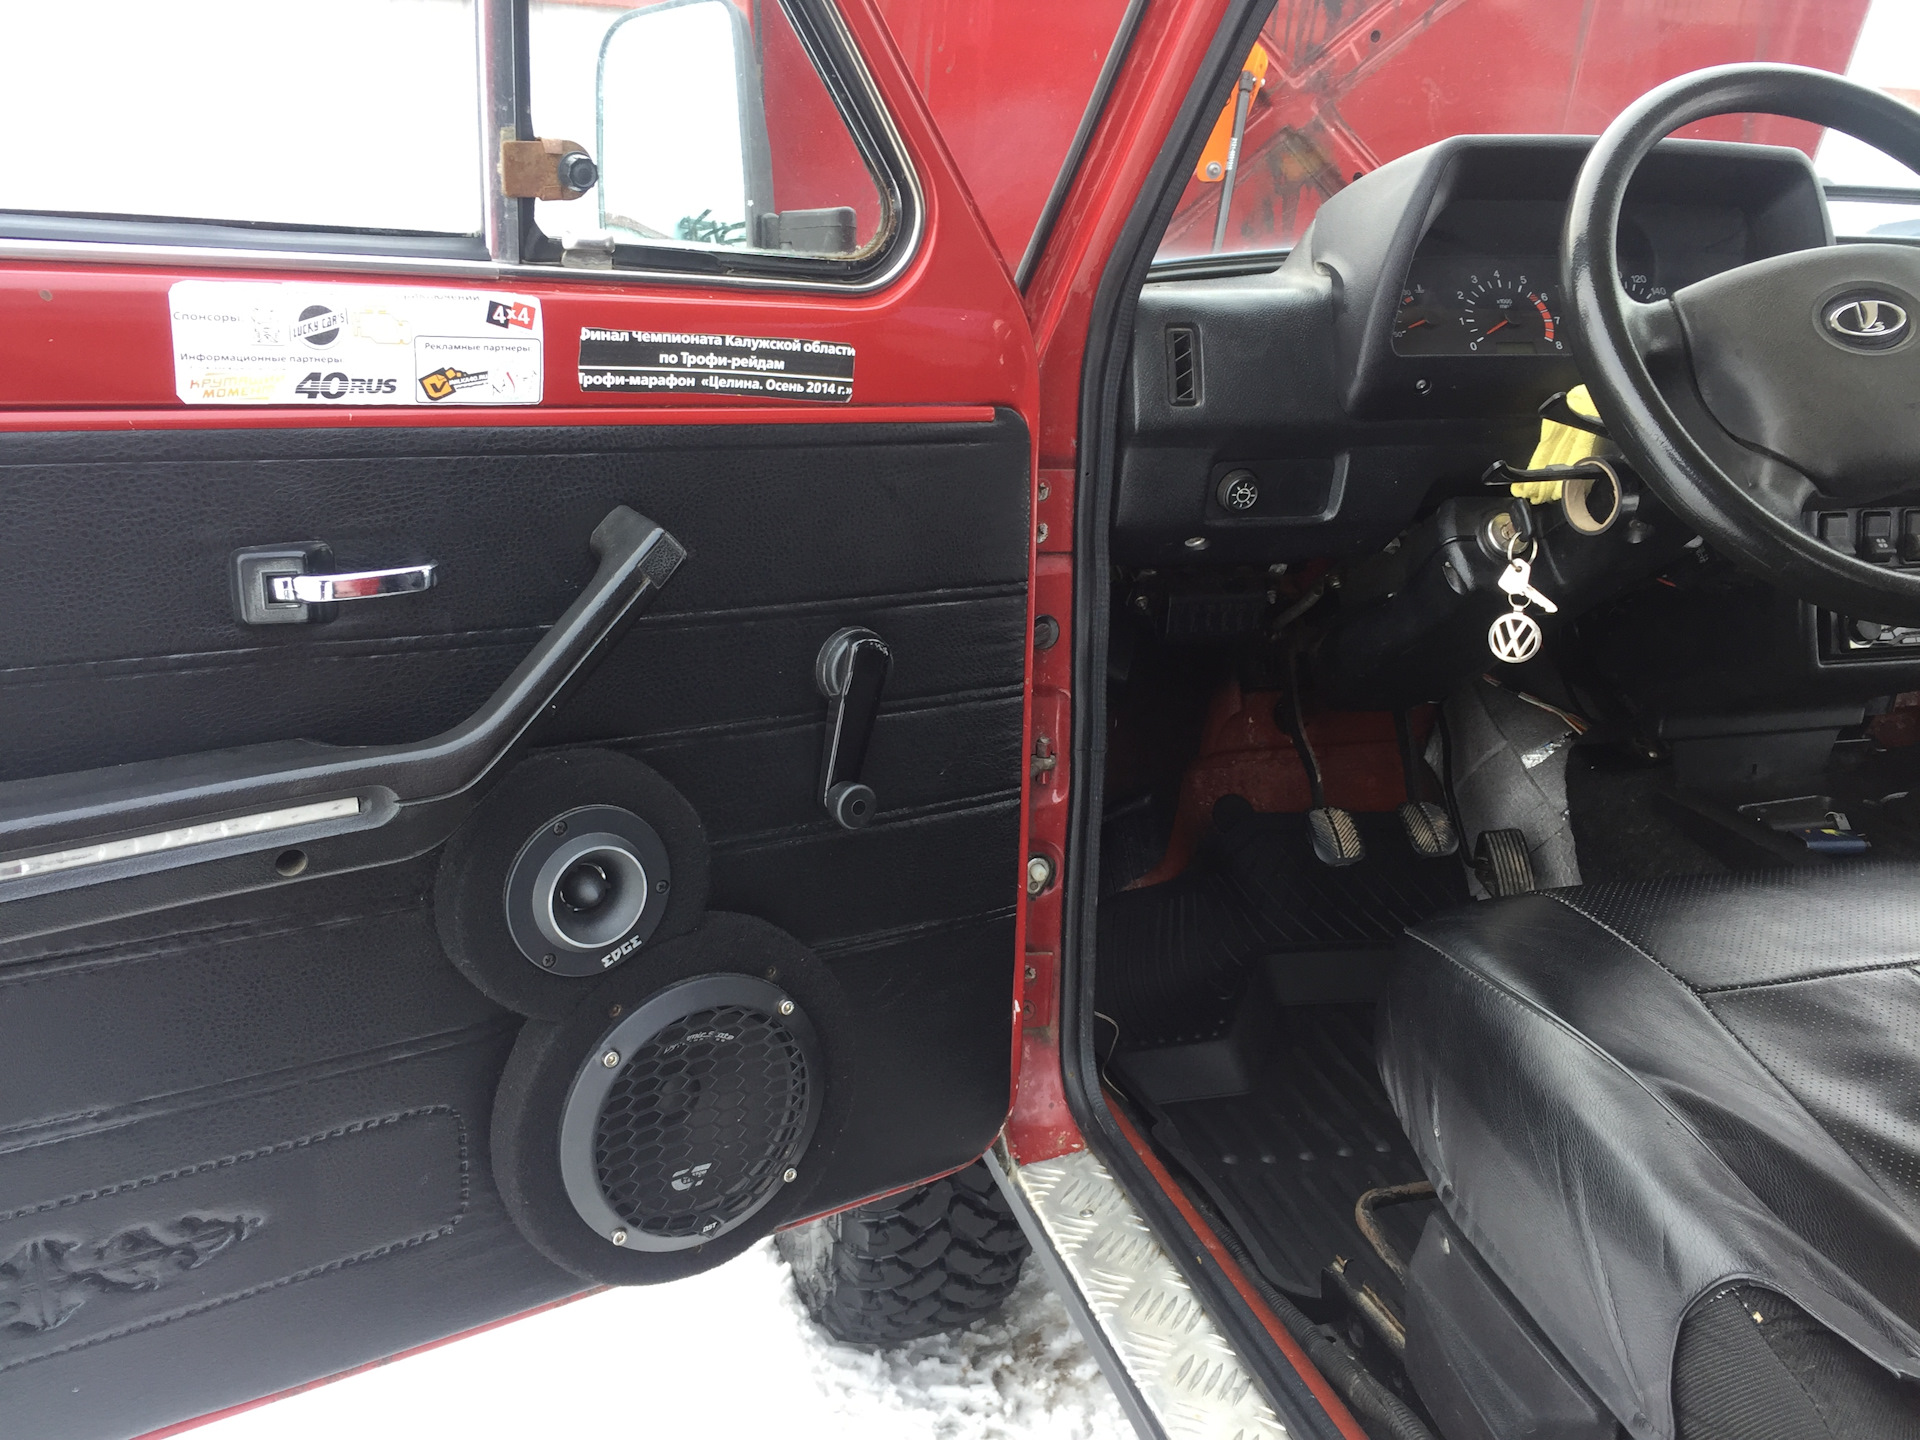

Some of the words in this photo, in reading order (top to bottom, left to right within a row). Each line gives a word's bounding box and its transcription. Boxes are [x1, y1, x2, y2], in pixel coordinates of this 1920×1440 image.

[1493, 269, 1501, 278] 4
[1470, 275, 1479, 284] 3
[1519, 275, 1528, 285] 5
[1631, 274, 1647, 284] 120
[1456, 290, 1465, 300] 2
[1650, 287, 1667, 296] 140
[1540, 292, 1549, 302] 6
[1458, 317, 1465, 326] 1
[1553, 316, 1561, 325] 7
[424, 342, 481, 351] Рекламные
[631, 330, 723, 346] Чемпионата
[725, 335, 801, 351] Калужской
[803, 340, 856, 357] области
[1469, 341, 1478, 351] 0
[1555, 340, 1563, 350] 8
[180, 353, 287, 363] Информационные
[659, 353, 679, 365] по
[681, 351, 786, 370] Трофи-рейдам
[578, 371, 696, 389] Трофи-марафон
[765, 378, 805, 393] Осень
[806, 381, 836, 395] 2014
[600, 934, 643, 969] EDGE
